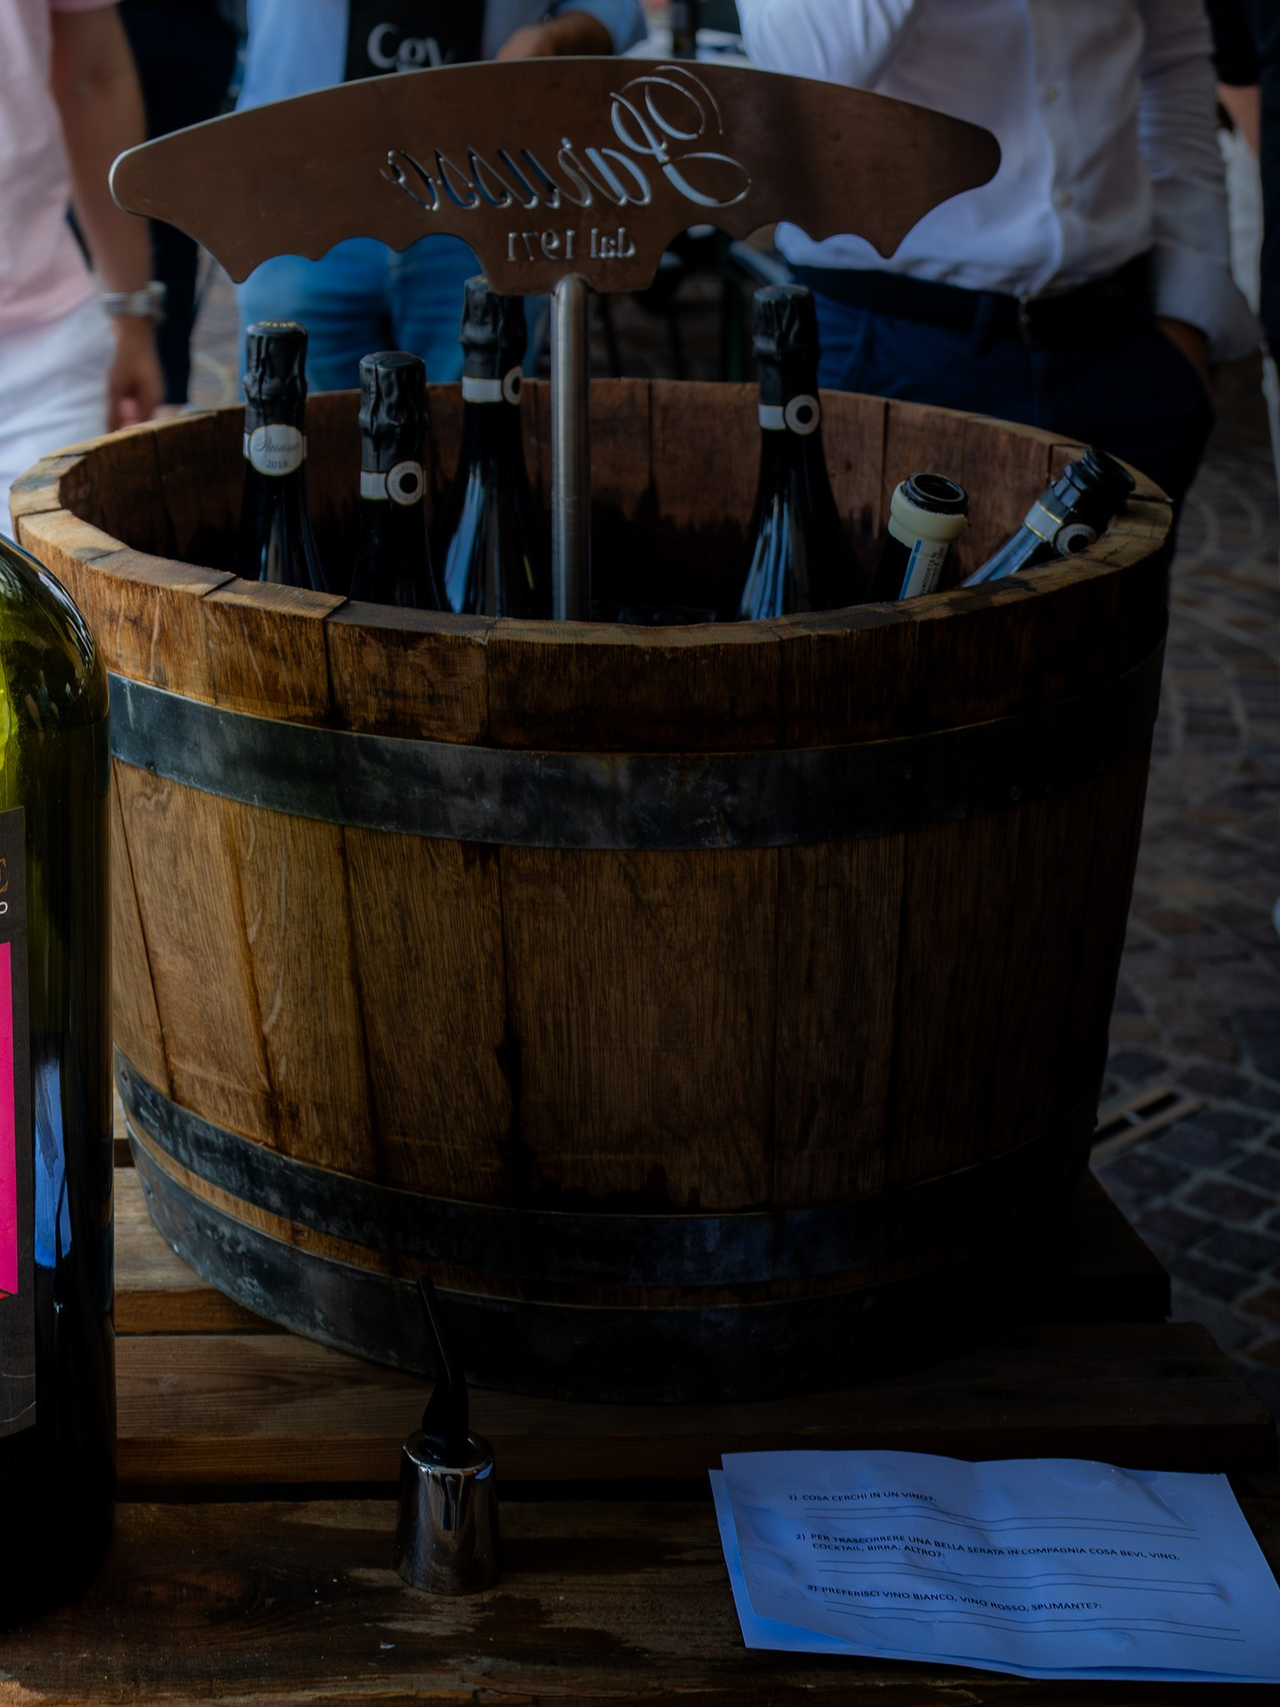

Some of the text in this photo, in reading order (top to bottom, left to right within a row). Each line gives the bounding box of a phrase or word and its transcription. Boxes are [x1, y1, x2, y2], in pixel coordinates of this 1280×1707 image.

[802, 1494, 830, 1502] COSA
[831, 1493, 868, 1501] CERCHI
[810, 1533, 830, 1542] PER
[833, 1535, 906, 1545] TRASCORRERE
[908, 1535, 932, 1546] UNA
[934, 1540, 966, 1552] BELLA
[968, 1546, 1006, 1556] SERATA
[1021, 1547, 1087, 1556] COMPAGNIA
[1089, 1547, 1117, 1556] COSA
[821, 1586, 880, 1598] PREFERISCI
[882, 1591, 910, 1599] VINO
[960, 1596, 988, 1607] VINO
